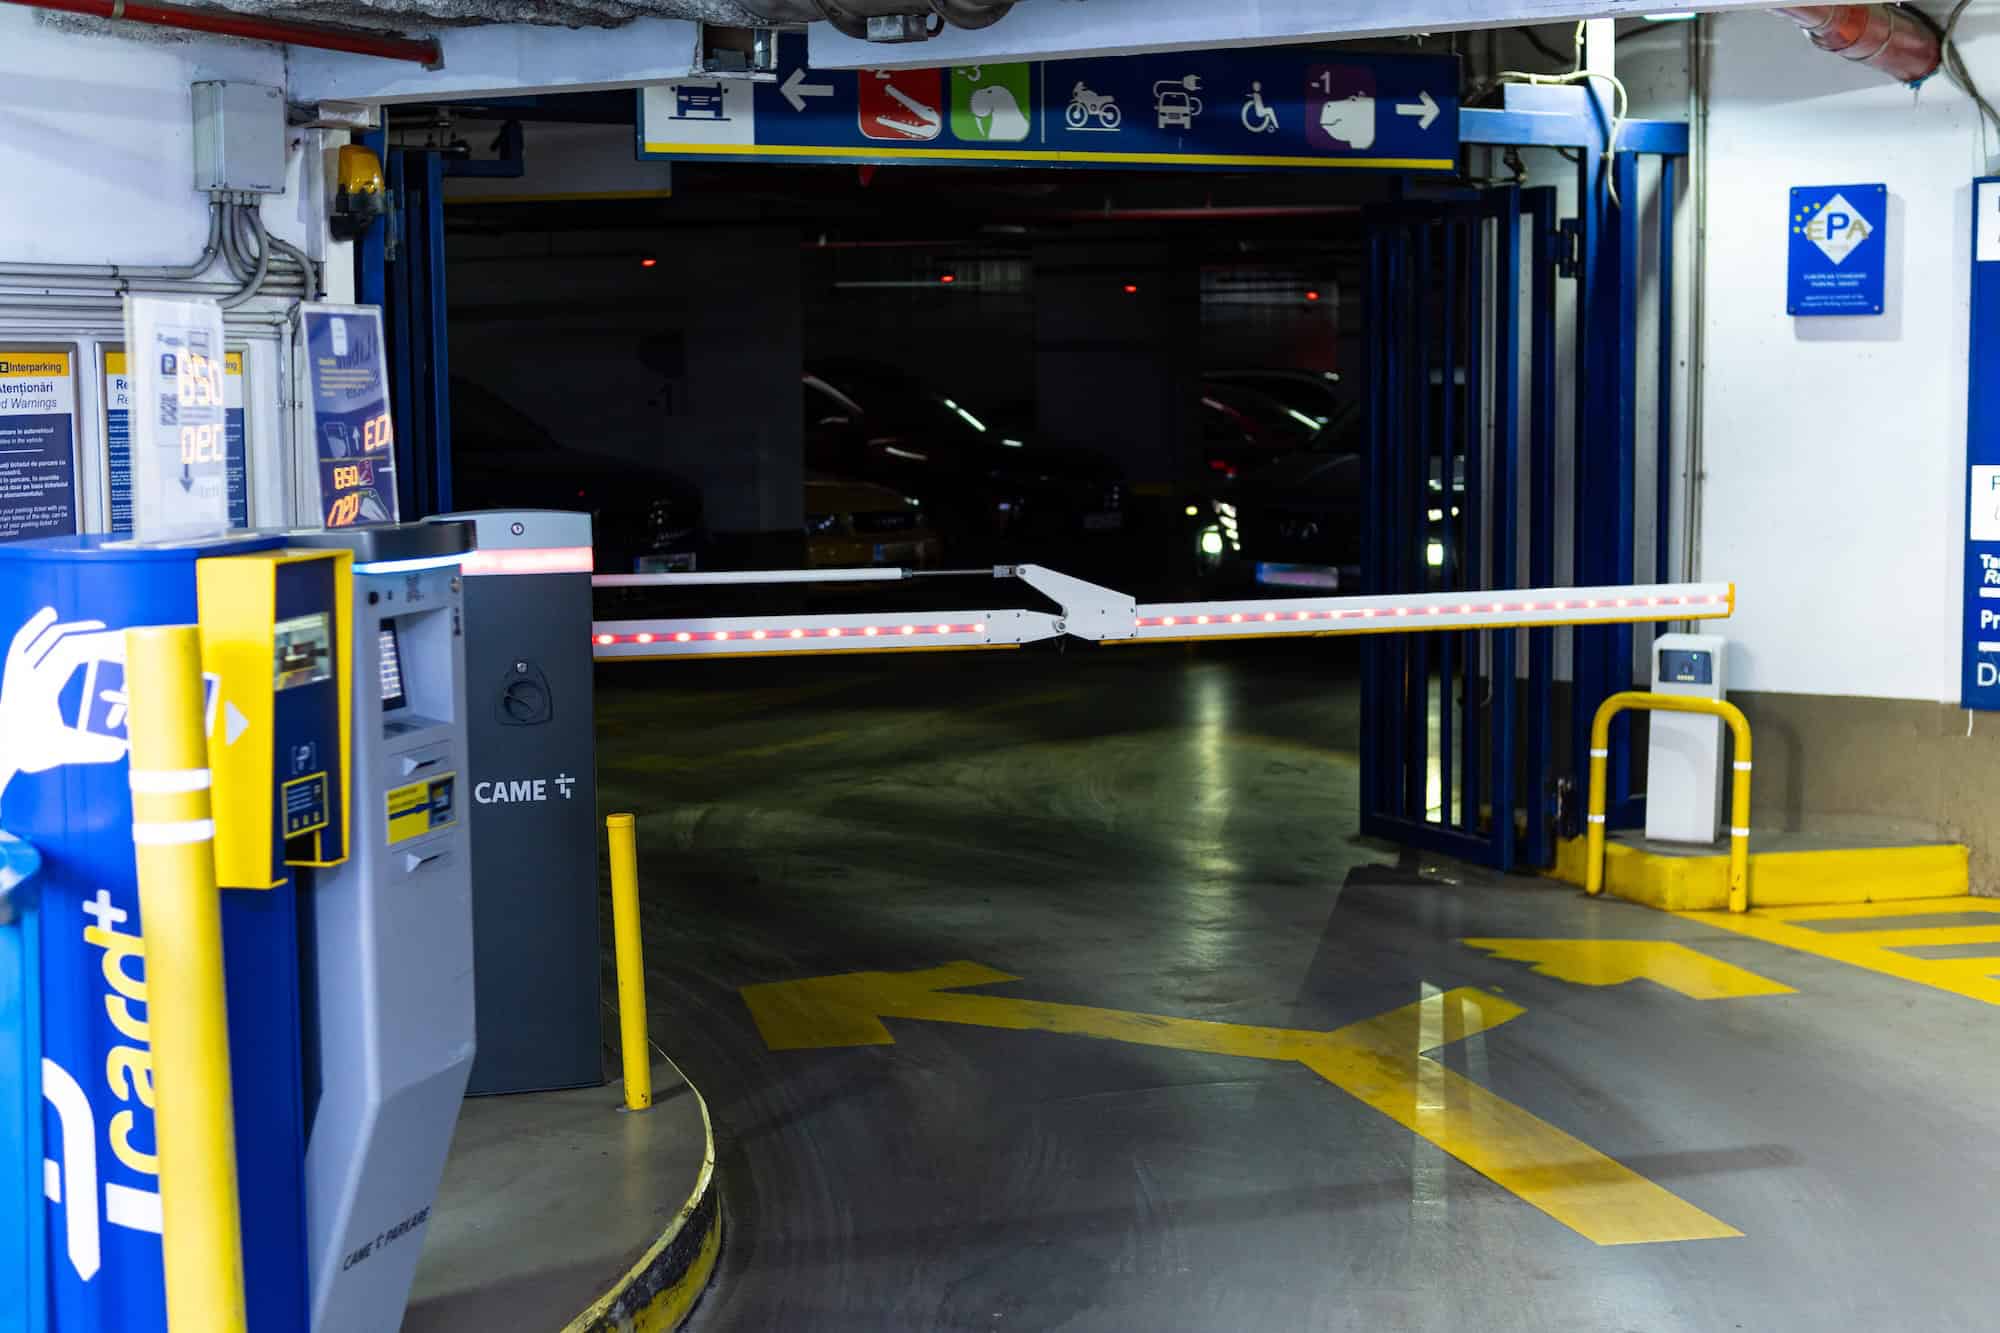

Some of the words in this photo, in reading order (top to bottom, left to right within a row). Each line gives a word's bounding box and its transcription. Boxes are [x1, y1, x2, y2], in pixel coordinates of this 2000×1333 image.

[1309, 71, 1333, 94] -1
[1806, 213, 1870, 241] EPA
[9, 362, 61, 374] Interparking
[10, 398, 57, 410] Warnings
[474, 779, 547, 804] CAME
[342, 1242, 374, 1272] CAME
